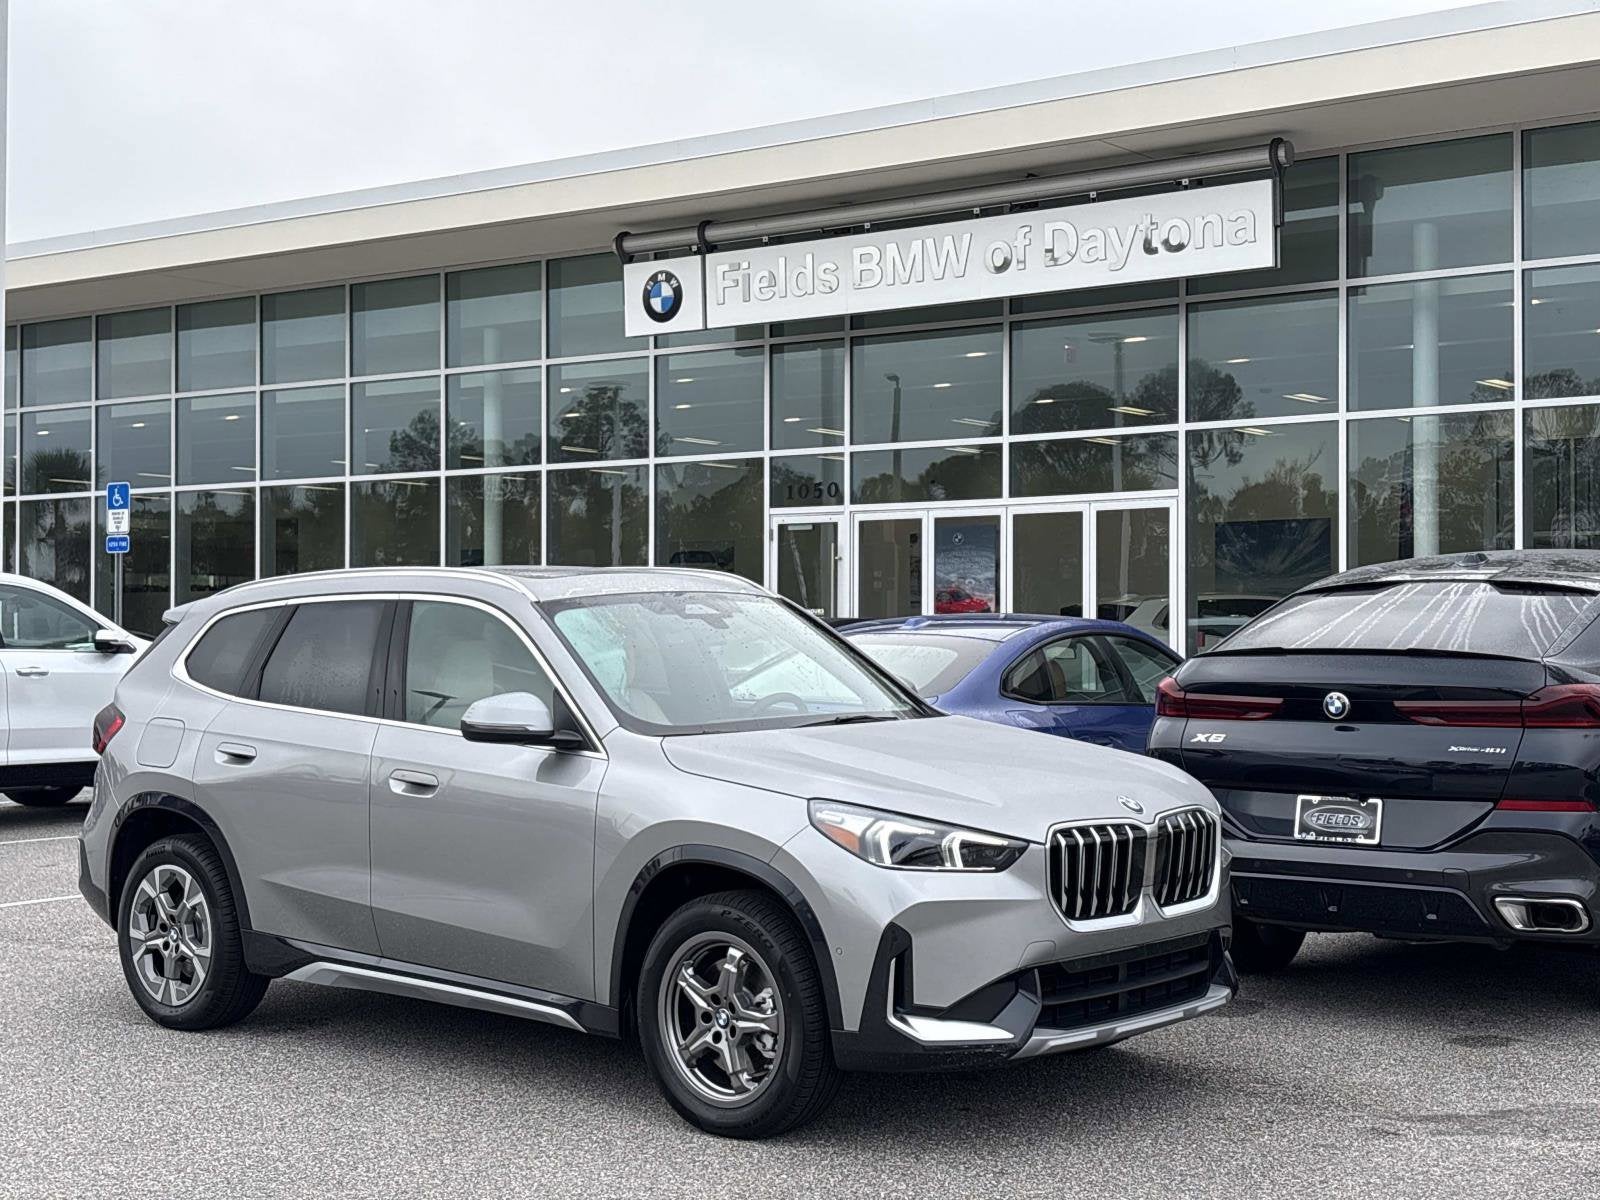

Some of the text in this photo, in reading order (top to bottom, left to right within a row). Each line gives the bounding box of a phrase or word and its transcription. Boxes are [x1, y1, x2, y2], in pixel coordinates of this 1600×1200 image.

[715, 208, 1257, 306] Fields BMW of Daytona
[786, 481, 840, 500] 1050
[1190, 733, 1227, 743] X6
[1313, 812, 1361, 827] FIELDS
